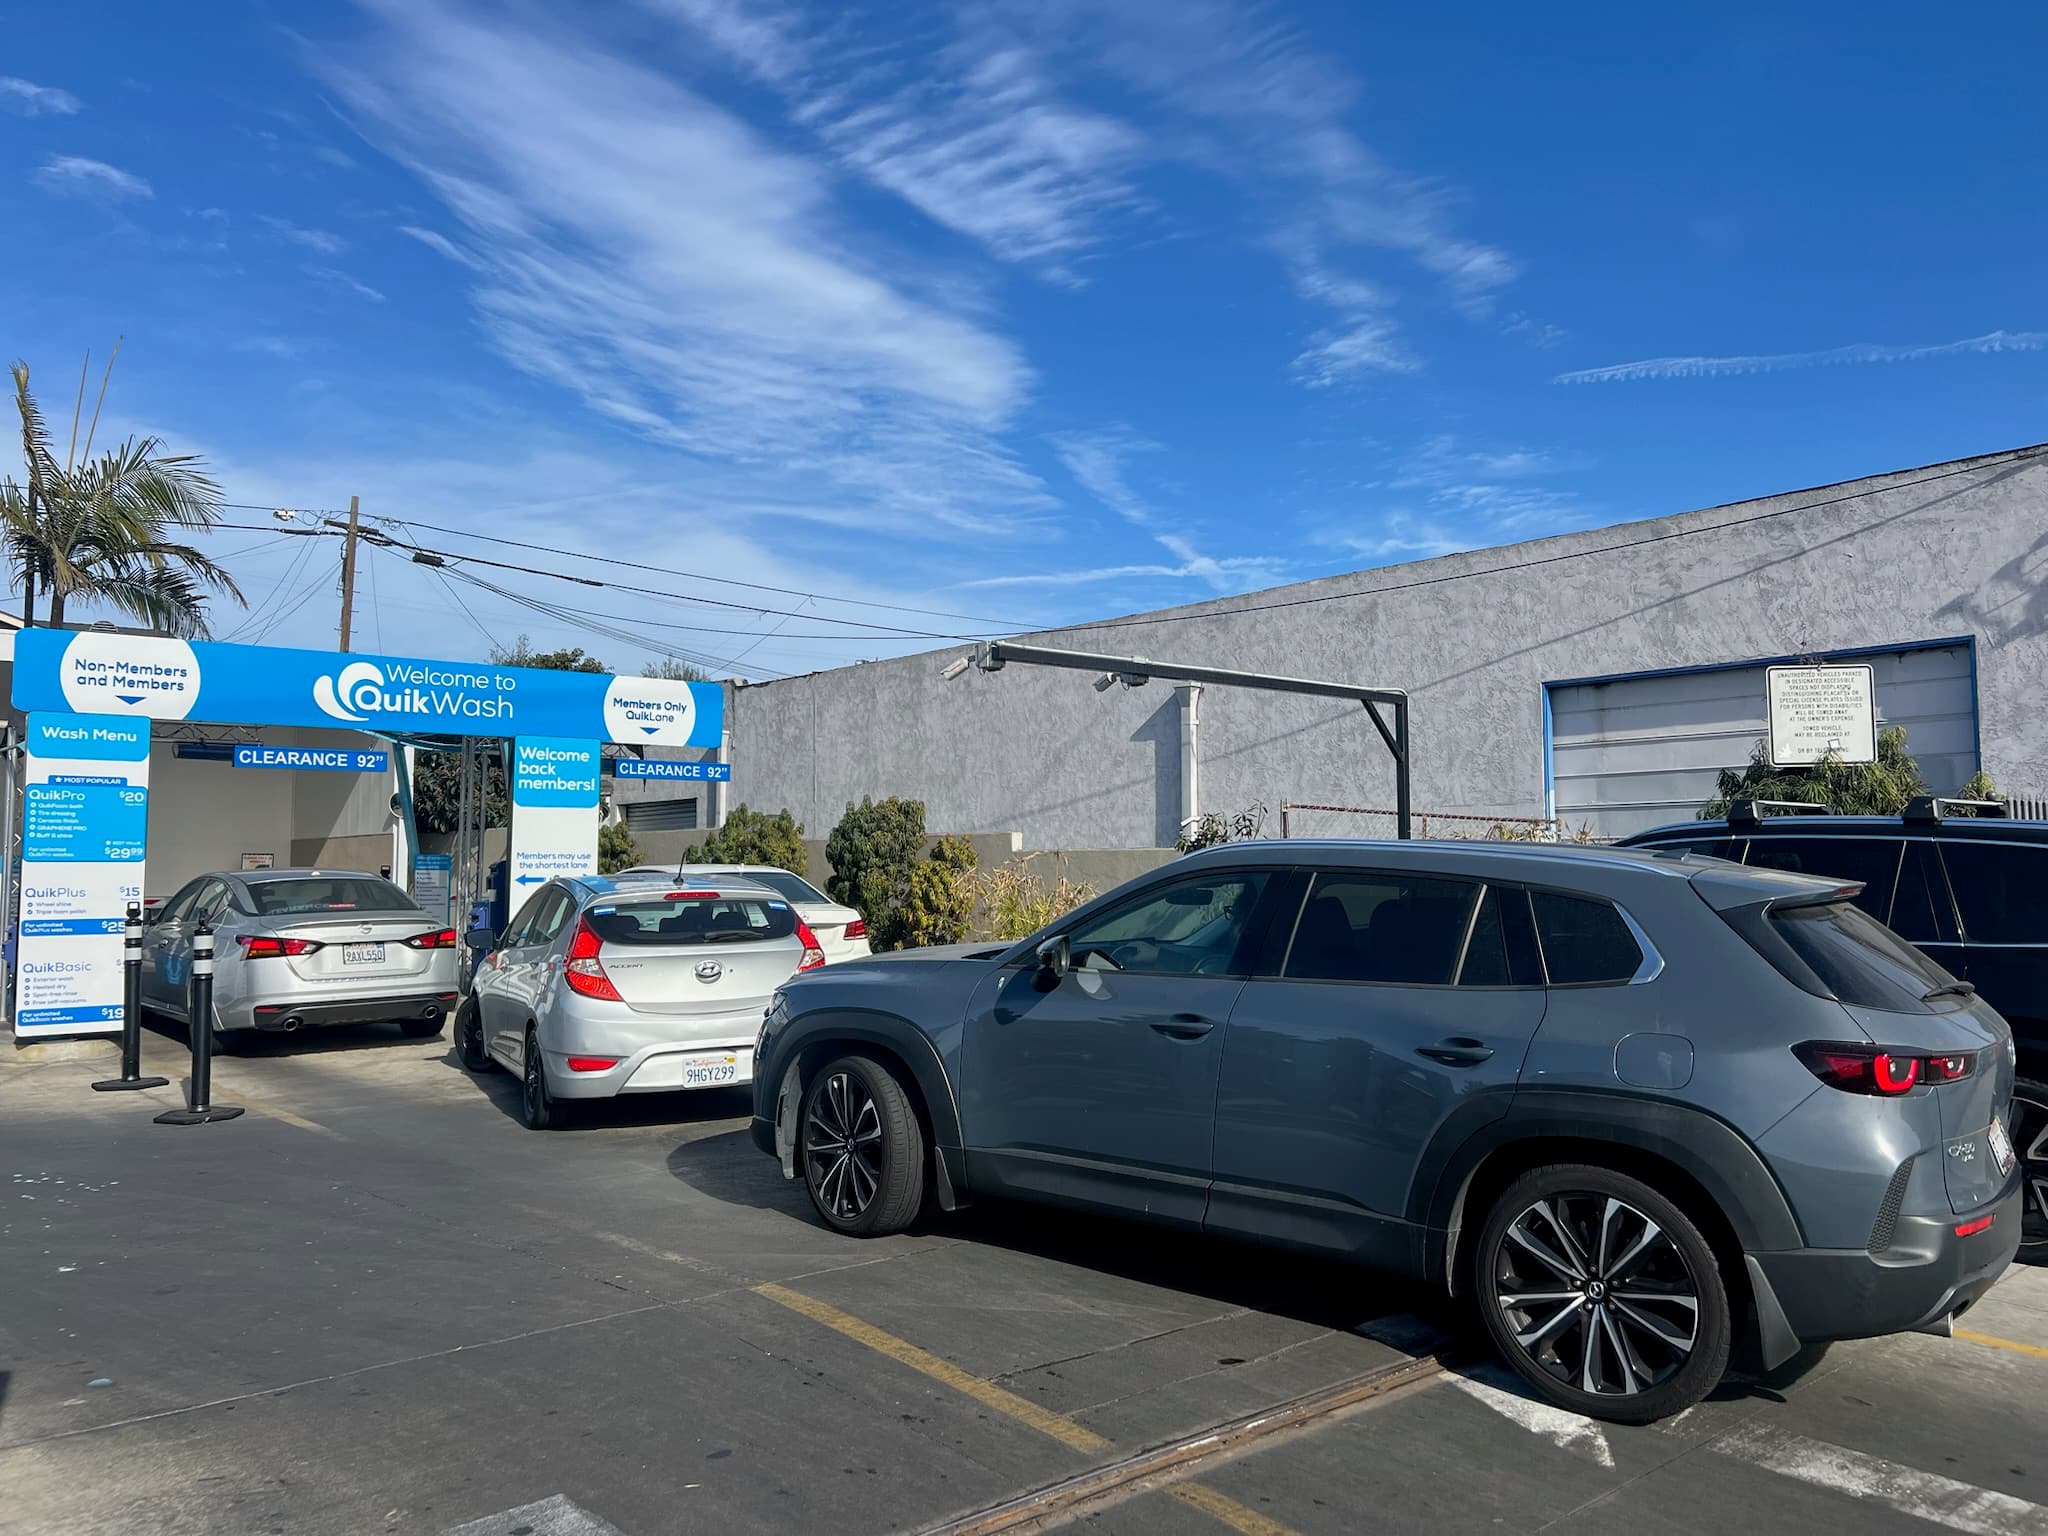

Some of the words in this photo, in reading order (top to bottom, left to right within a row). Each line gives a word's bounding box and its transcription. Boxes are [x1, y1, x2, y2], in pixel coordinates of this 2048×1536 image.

[75, 659, 188, 678] Non-Members
[77, 675, 108, 687] and
[113, 675, 185, 691] Members
[386, 663, 490, 690] Welcome
[494, 673, 516, 691] to
[354, 685, 514, 719] QuikWash
[613, 697, 662, 711] Members
[664, 701, 687, 714] Only
[626, 710, 675, 723] QuikLane
[42, 726, 88, 740] Wash
[93, 728, 137, 742] Menu
[239, 750, 348, 767] CLEARANCE
[519, 746, 590, 763] Welcome
[519, 762, 556, 776] back
[619, 762, 700, 777] CLEARANCE
[518, 777, 595, 791] members!
[29, 789, 86, 801] QuikPro
[119, 791, 144, 802] $20
[516, 852, 557, 860] Members
[558, 854, 575, 862] may
[25, 887, 86, 898] QuikPlus
[119, 886, 141, 897] $15
[23, 961, 92, 973] QuikBasic
[687, 1065, 735, 1083] 9HGY299
